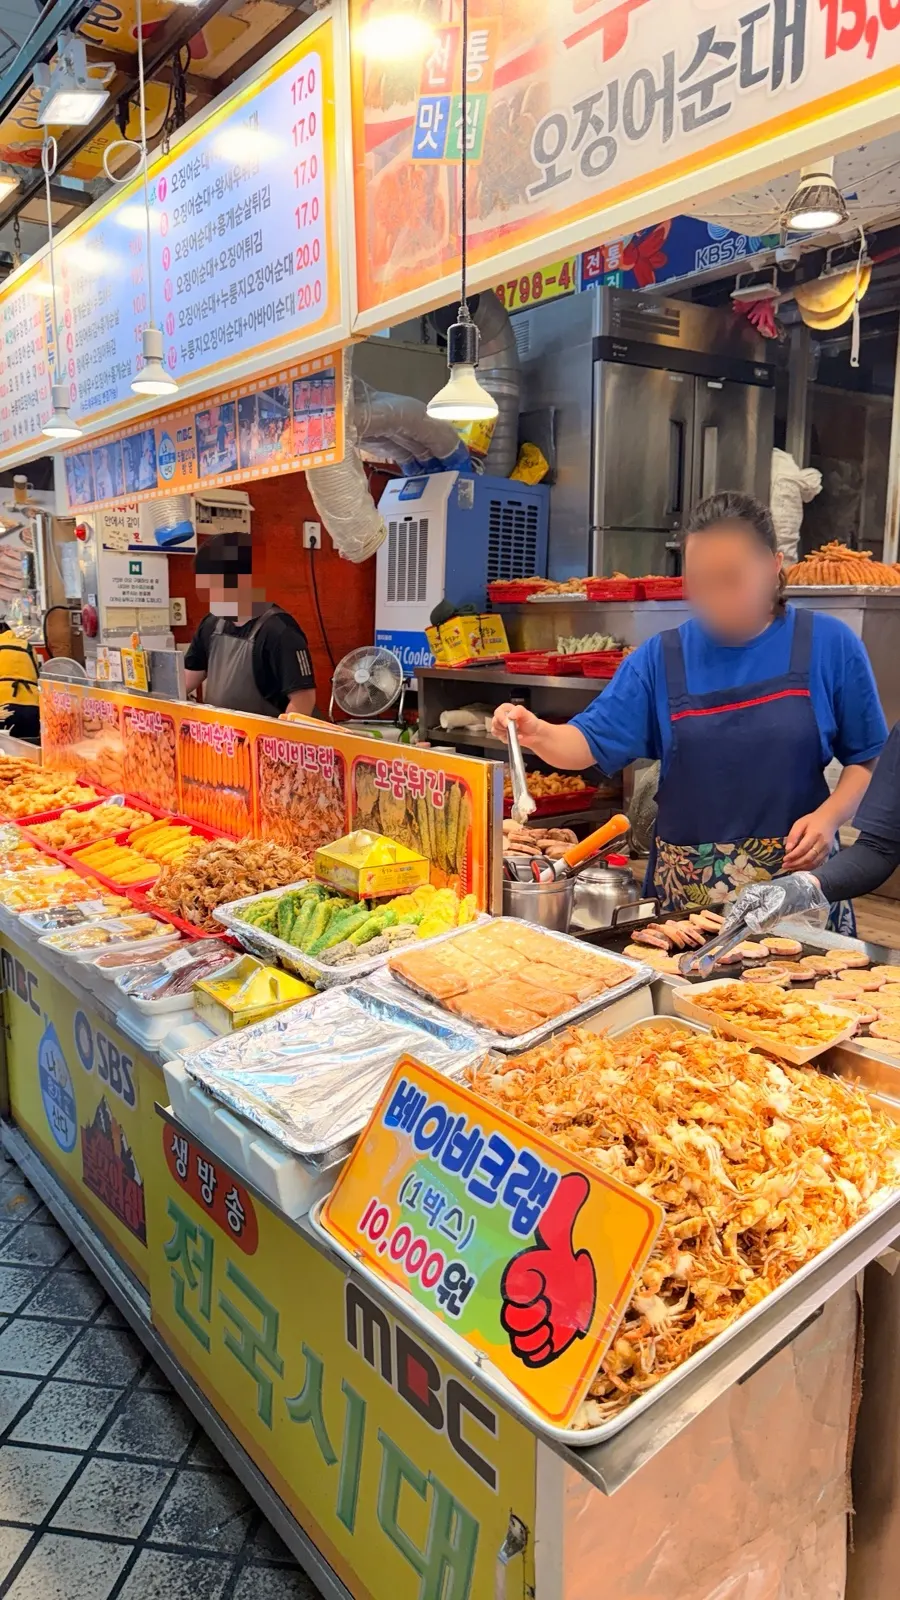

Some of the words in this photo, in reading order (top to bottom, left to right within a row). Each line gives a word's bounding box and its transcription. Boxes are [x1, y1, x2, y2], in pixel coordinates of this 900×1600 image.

[291, 68, 315, 105] 17.0
[528, 0, 807, 197] 오징어순대
[292, 111, 316, 147] 17.0
[417, 98, 480, 151] 맛집
[293, 154, 317, 189] 17.0
[176, 229, 262, 296] 오징어순대+오징어튀김
[295, 196, 319, 230] 17.0
[586, 242, 623, 272] 전통
[695, 235, 747, 270] KBS2
[178, 252, 294, 329] 오징어순대+누룽지오징어순대
[296, 238, 320, 271] 20.0
[496, 261, 577, 306] 8798-4
[180, 292, 296, 364] 누룽지오징어순대+아바이순대
[297, 279, 321, 312] 20.0
[176, 426, 193, 443] MBC
[104, 515, 125, 528] 안에서
[126, 516, 140, 529] 같이
[403, 647, 435, 666] Cooler
[190, 721, 235, 757] 대게순살
[263, 738, 336, 779] 베이비크랩
[1, 948, 41, 1016] MBC
[96, 1031, 136, 1107] SBS
[52, 1108, 69, 1143] 산다
[172, 1131, 246, 1238] 생방송
[384, 1080, 559, 1236] 베이비크랩
[399, 1173, 475, 1251] (1박스)
[359, 1199, 475, 1317] 10,000원
[163, 1196, 480, 1600] 전국시대
[347, 1283, 497, 1492] MBC
